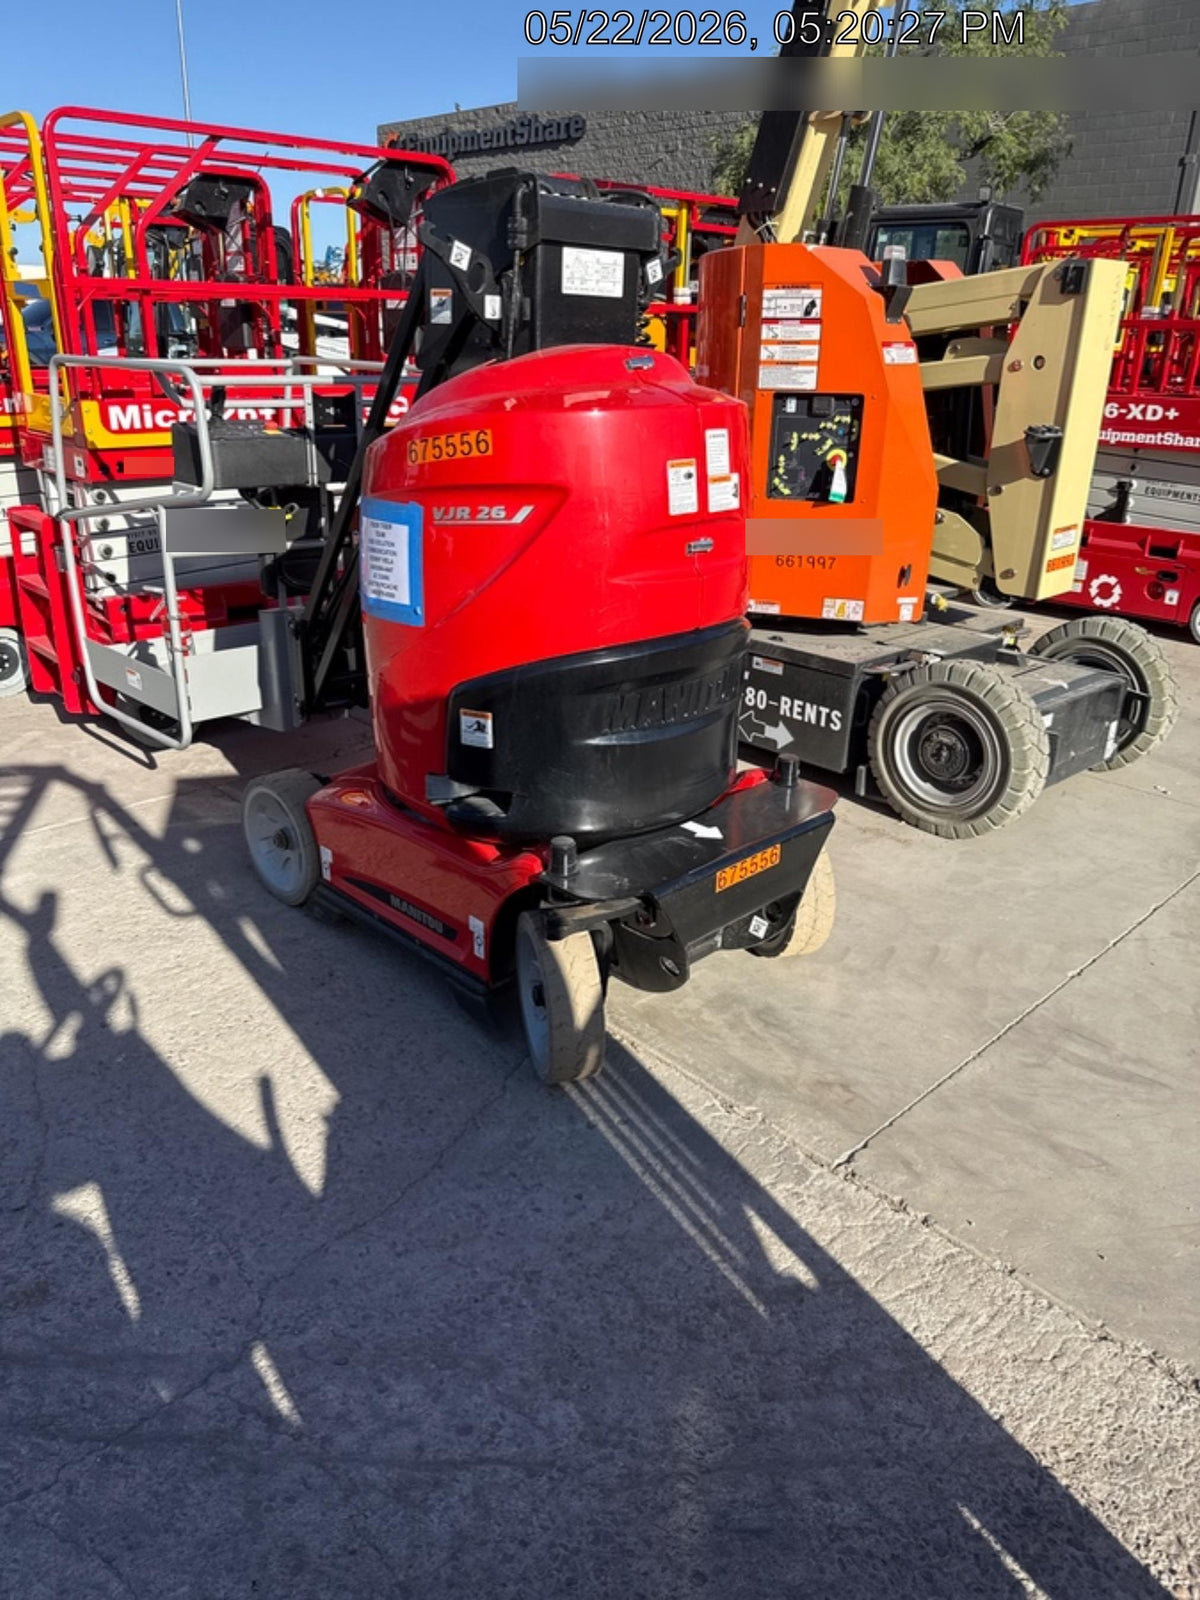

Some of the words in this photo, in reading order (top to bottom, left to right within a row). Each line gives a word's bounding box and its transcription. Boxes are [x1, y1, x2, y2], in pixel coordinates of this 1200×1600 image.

[408, 430, 490, 464] 675556
[1145, 486, 1200, 502] EQUIPMENT
[432, 506, 470, 520] VJR
[476, 505, 507, 519] 26
[776, 555, 836, 569] 661997
[718, 845, 779, 889] 675556
